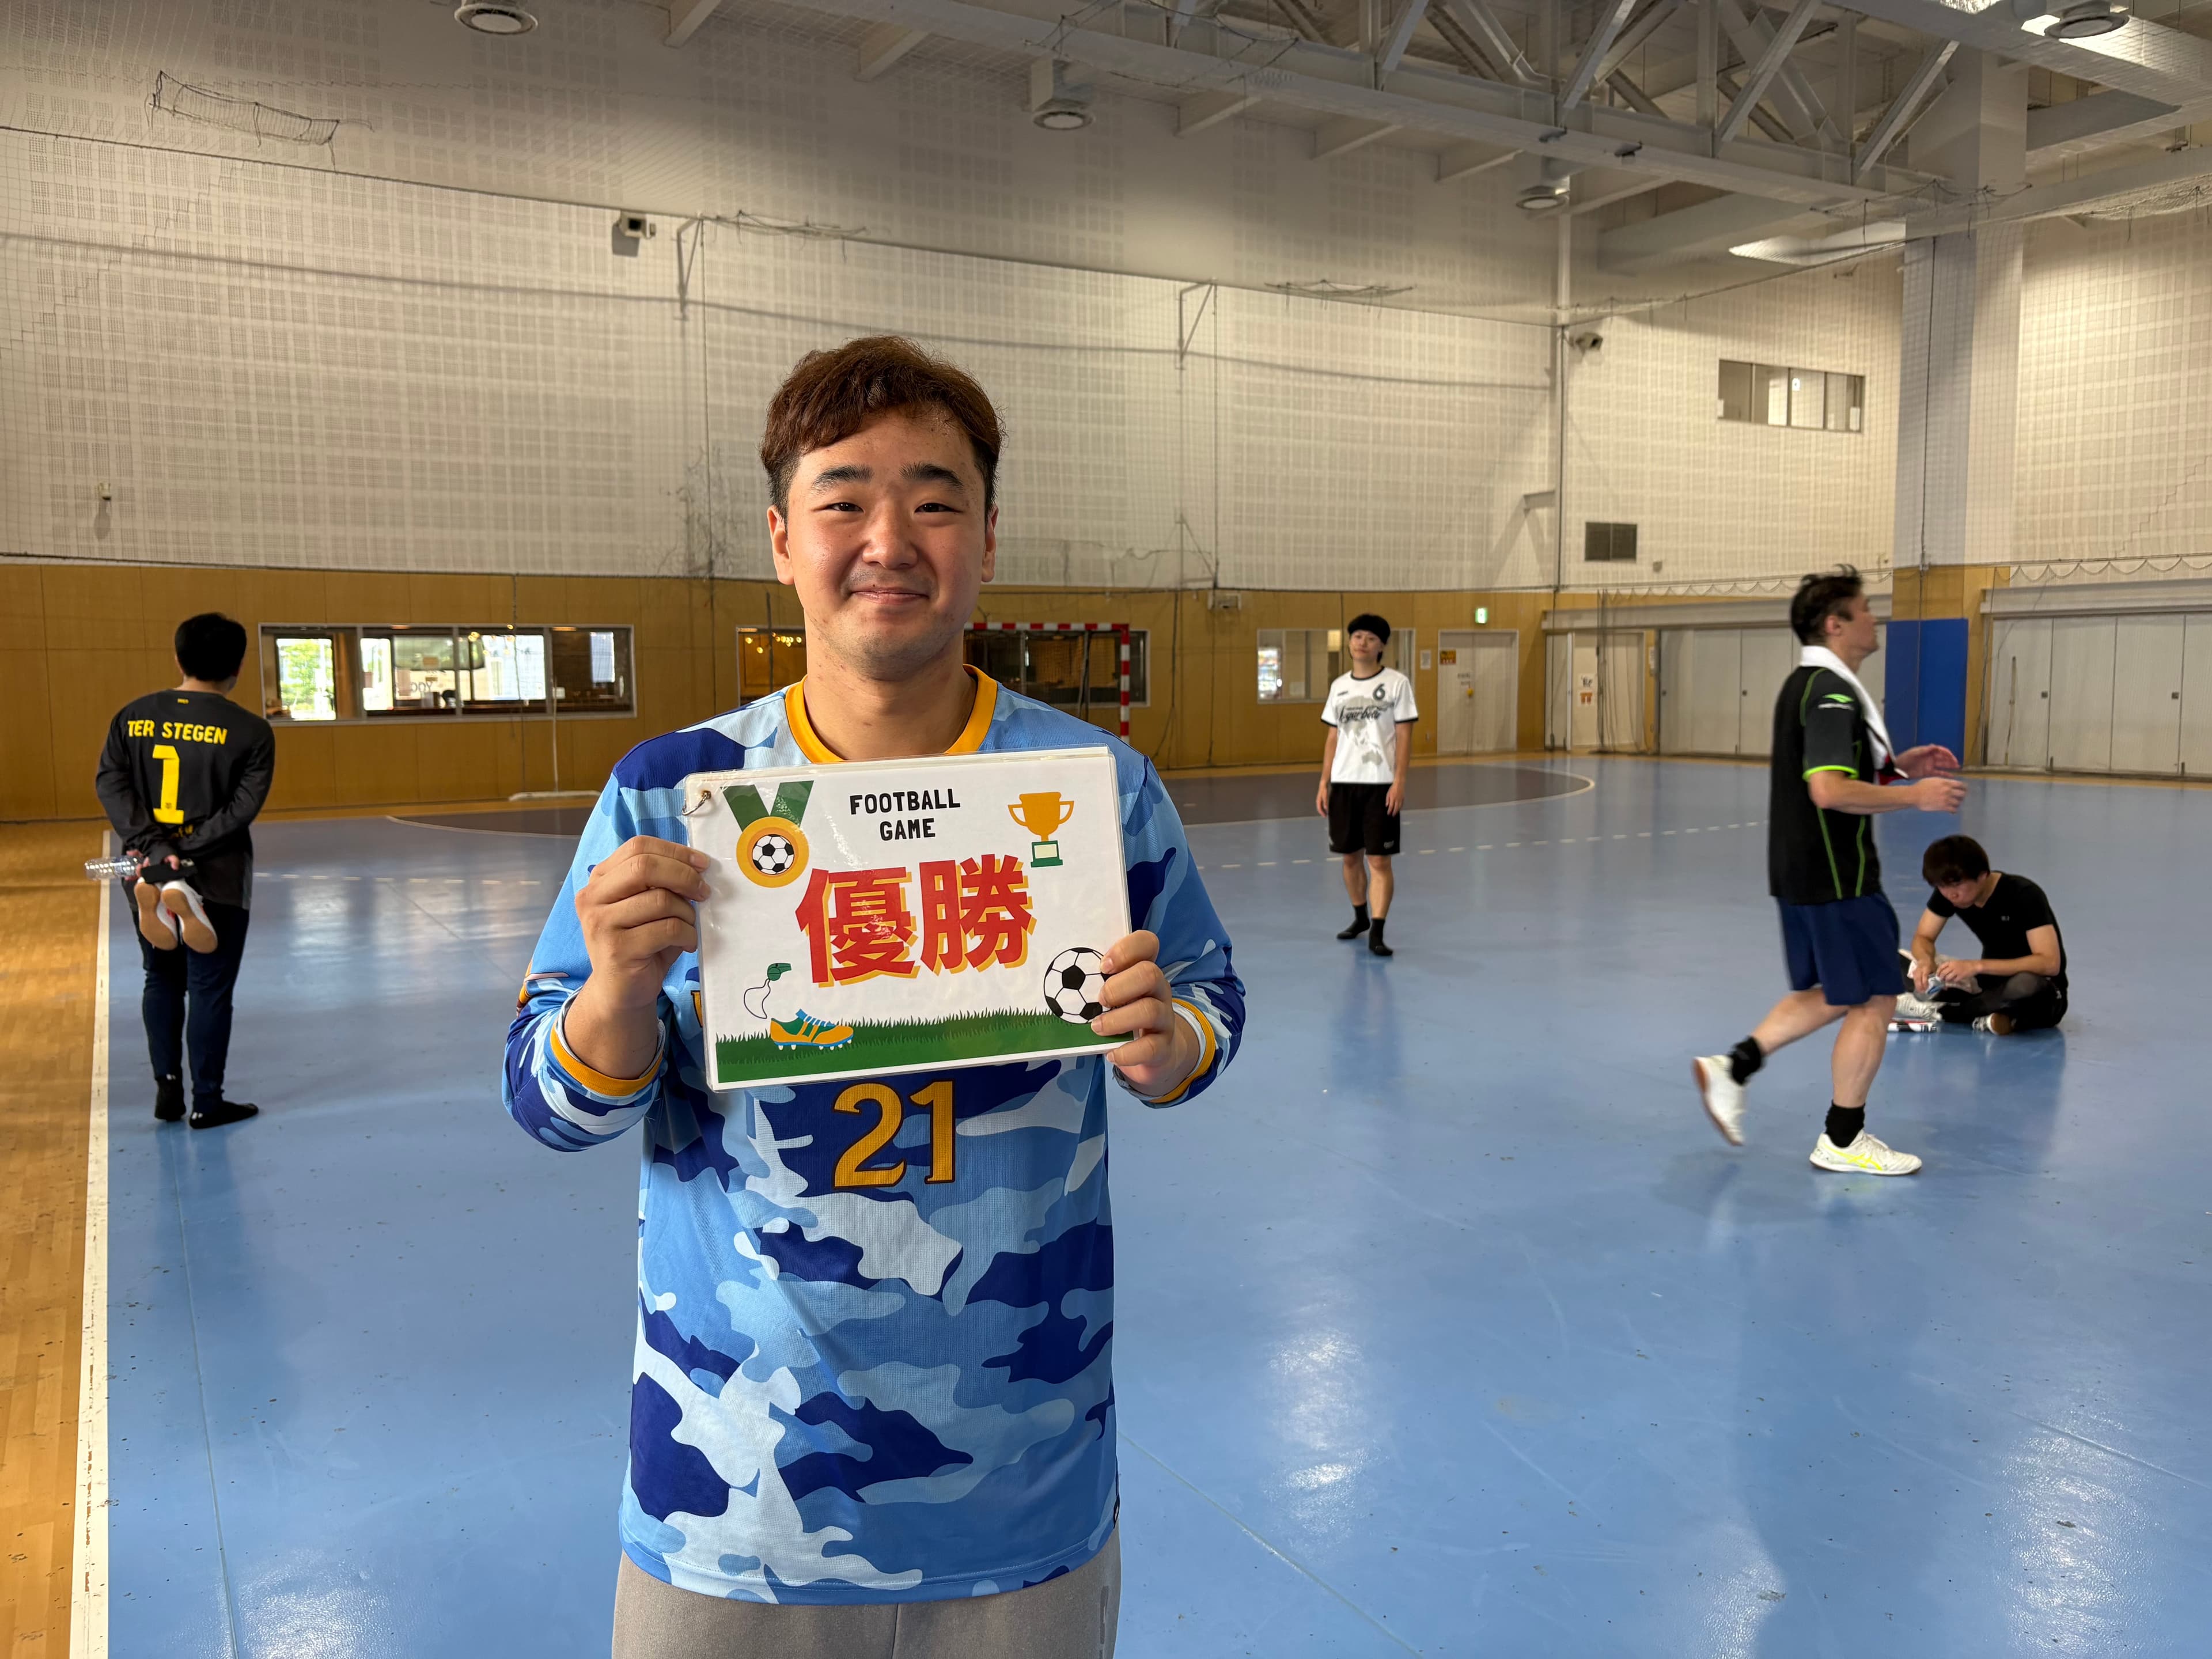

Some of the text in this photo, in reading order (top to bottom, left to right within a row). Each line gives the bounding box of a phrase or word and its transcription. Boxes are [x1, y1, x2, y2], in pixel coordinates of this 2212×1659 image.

[1373, 683, 1385, 700] 6
[127, 719, 228, 745] TER STEGEN
[152, 744, 185, 824] 1
[850, 788, 961, 815] FOOTBALL
[879, 817, 935, 841] GAME
[795, 853, 1037, 988] 優勝
[832, 1079, 956, 1189] 21
